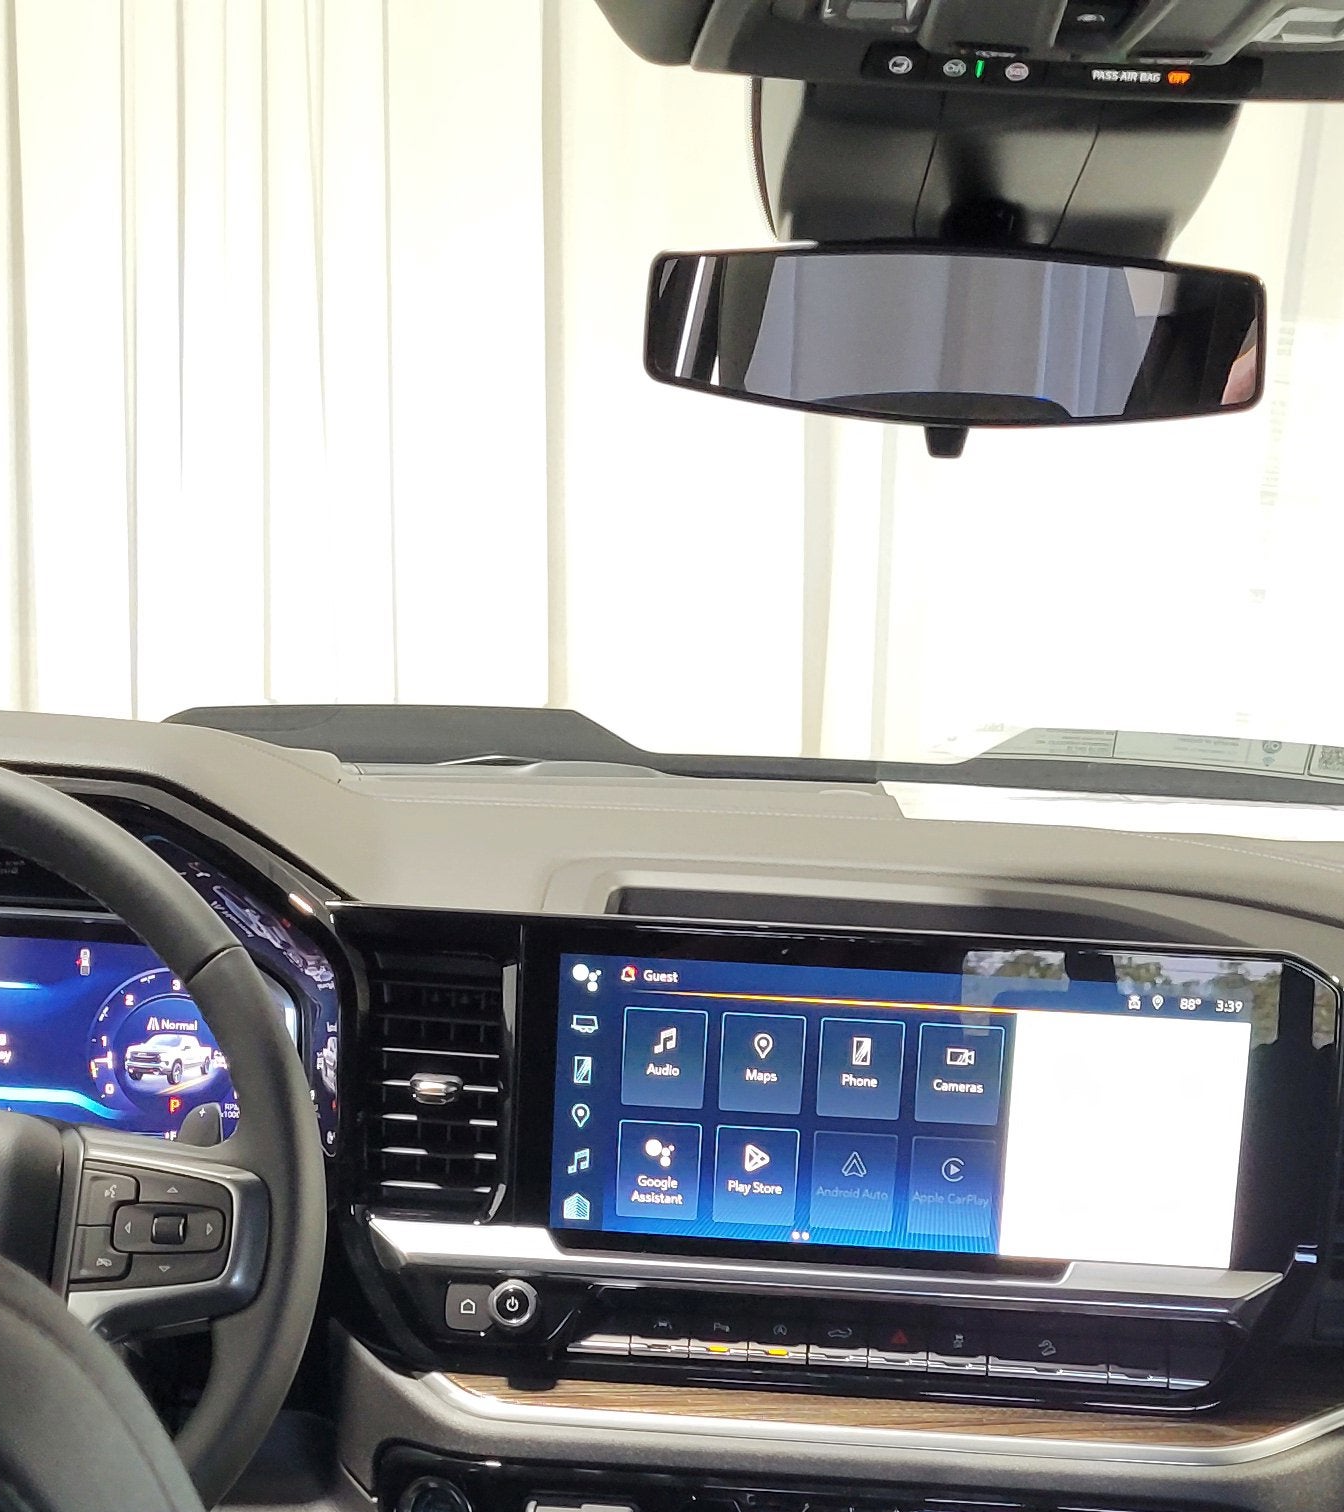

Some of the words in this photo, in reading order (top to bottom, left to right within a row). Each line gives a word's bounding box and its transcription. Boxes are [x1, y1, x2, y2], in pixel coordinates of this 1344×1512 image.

[1092, 69, 1119, 81] PASS
[1120, 70, 1138, 82] AIR
[1140, 72, 1161, 83] BAG
[643, 969, 679, 983] Guest
[125, 994, 134, 1006] 2
[1215, 1000, 1244, 1013] 3:39
[161, 1020, 198, 1031] Normal
[646, 1063, 680, 1077] Audio
[745, 1068, 777, 1084] Maps
[841, 1073, 878, 1088] Phone
[933, 1078, 984, 1094] Cameras
[169, 1097, 181, 1114] P
[637, 1175, 678, 1191] Google
[728, 1179, 751, 1196] Play
[752, 1181, 782, 1195] Store
[631, 1190, 683, 1205] Assistant
[816, 1185, 859, 1199] Android
[862, 1188, 889, 1200] Auto
[913, 1191, 944, 1205] Apple
[947, 1193, 989, 1208] CarPlay
